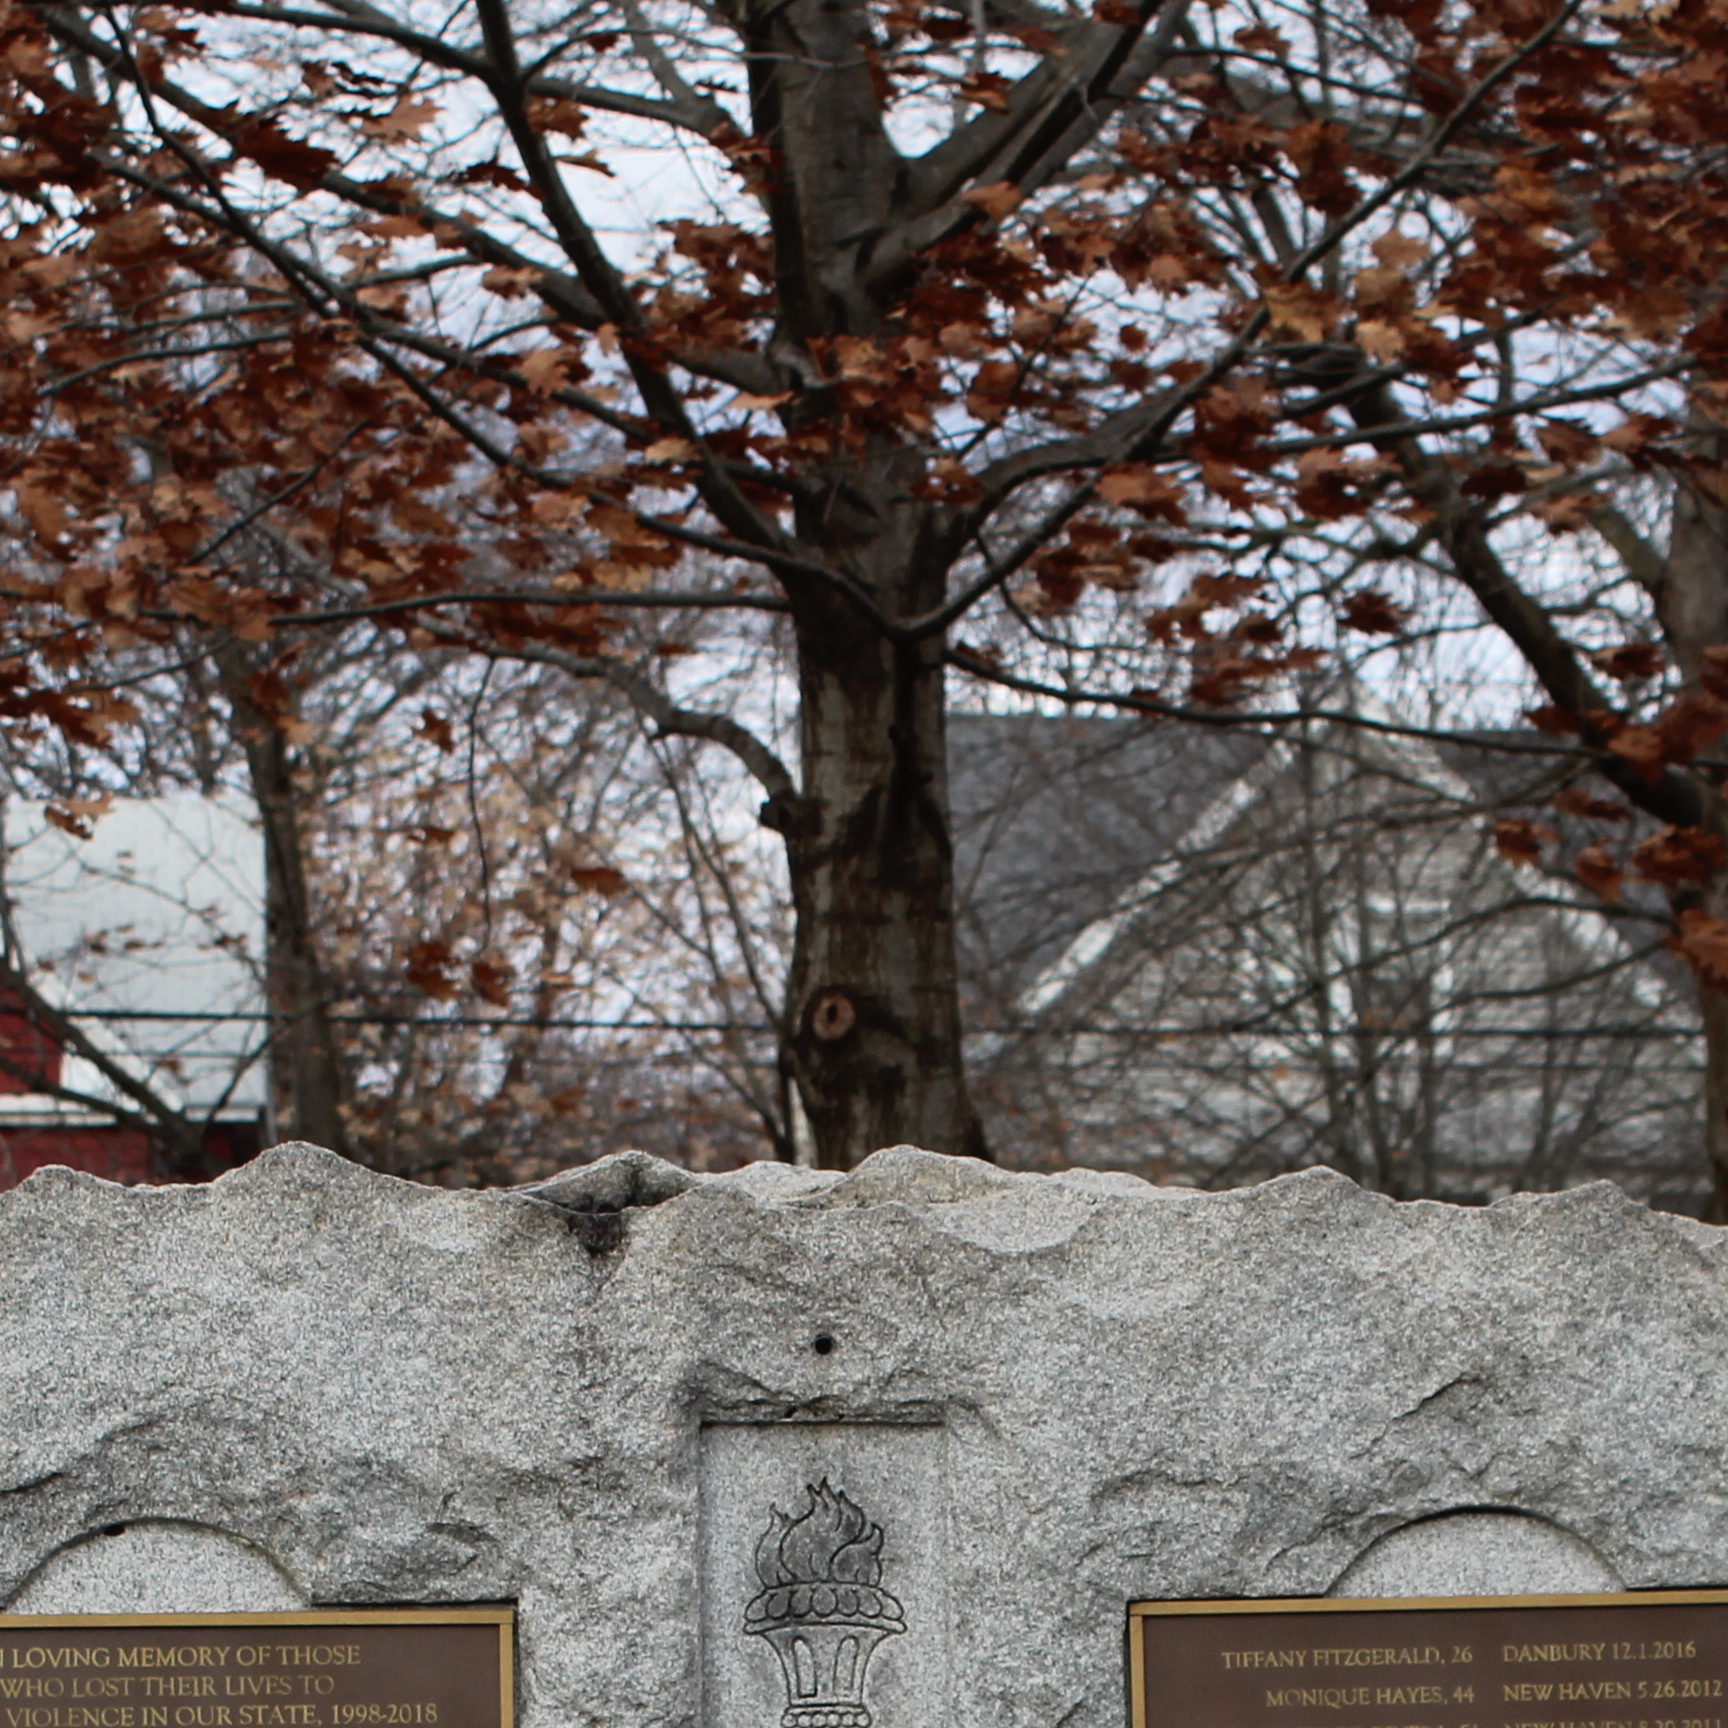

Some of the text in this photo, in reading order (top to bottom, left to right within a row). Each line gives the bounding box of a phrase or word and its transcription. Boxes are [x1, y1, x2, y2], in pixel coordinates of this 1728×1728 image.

[12, 1647, 110, 1668] LOVING
[117, 1646, 230, 1667] MEMORY
[236, 1646, 271, 1666] OF
[276, 1645, 360, 1665] THOSE
[1221, 1646, 1473, 1669] TIFFANY FITZGERALD, 26
[1503, 1640, 1696, 1662] DANBURY 12.1.2016
[72, 1677, 135, 1698] LOST
[141, 1676, 217, 1697] THEIR
[225, 1676, 291, 1696] LIVES
[298, 1675, 334, 1694] TO
[1266, 1686, 1475, 1709] MONIQUE HAYES, 44
[1503, 1680, 1722, 1701] NEW HAVEN 5.26.2012
[6, 1707, 135, 1728] VIOLENCE
[142, 1707, 167, 1726] IN
[175, 1706, 232, 1726] OUR
[239, 1704, 322, 1726] STATE,
[332, 1703, 437, 1724] 1998-2018
